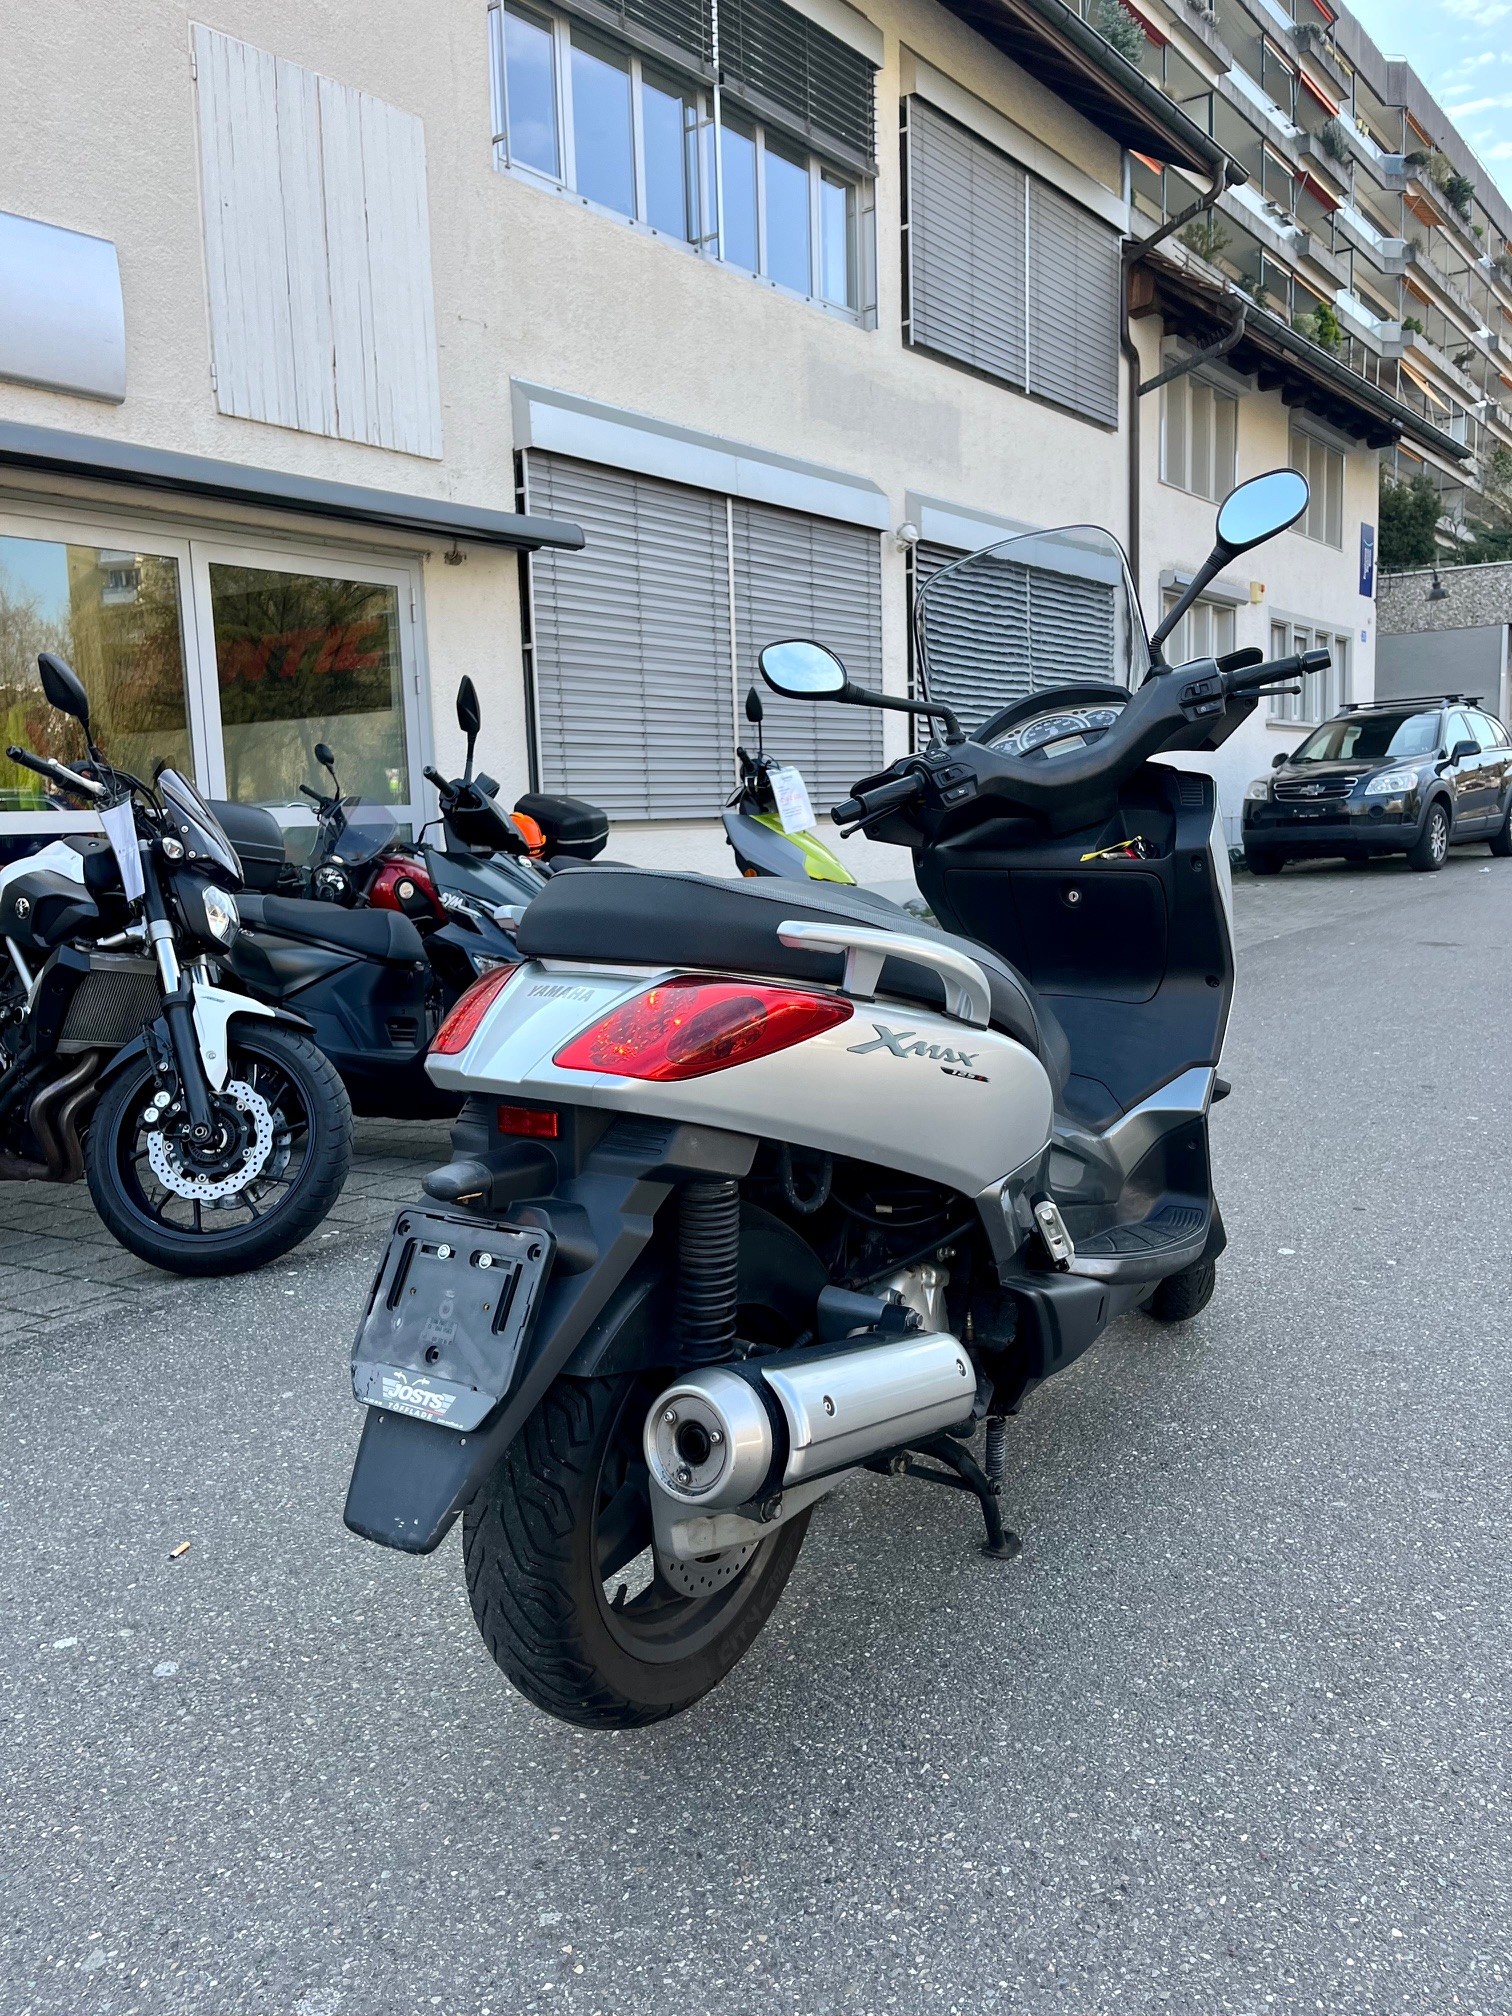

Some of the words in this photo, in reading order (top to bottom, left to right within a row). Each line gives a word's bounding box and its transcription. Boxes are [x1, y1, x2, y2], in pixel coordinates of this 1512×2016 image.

[217, 618, 385, 684] NTIC
[439, 892, 464, 908] SYM
[527, 985, 595, 1002] YAMAHA
[387, 1383, 445, 1409] JOSTS
